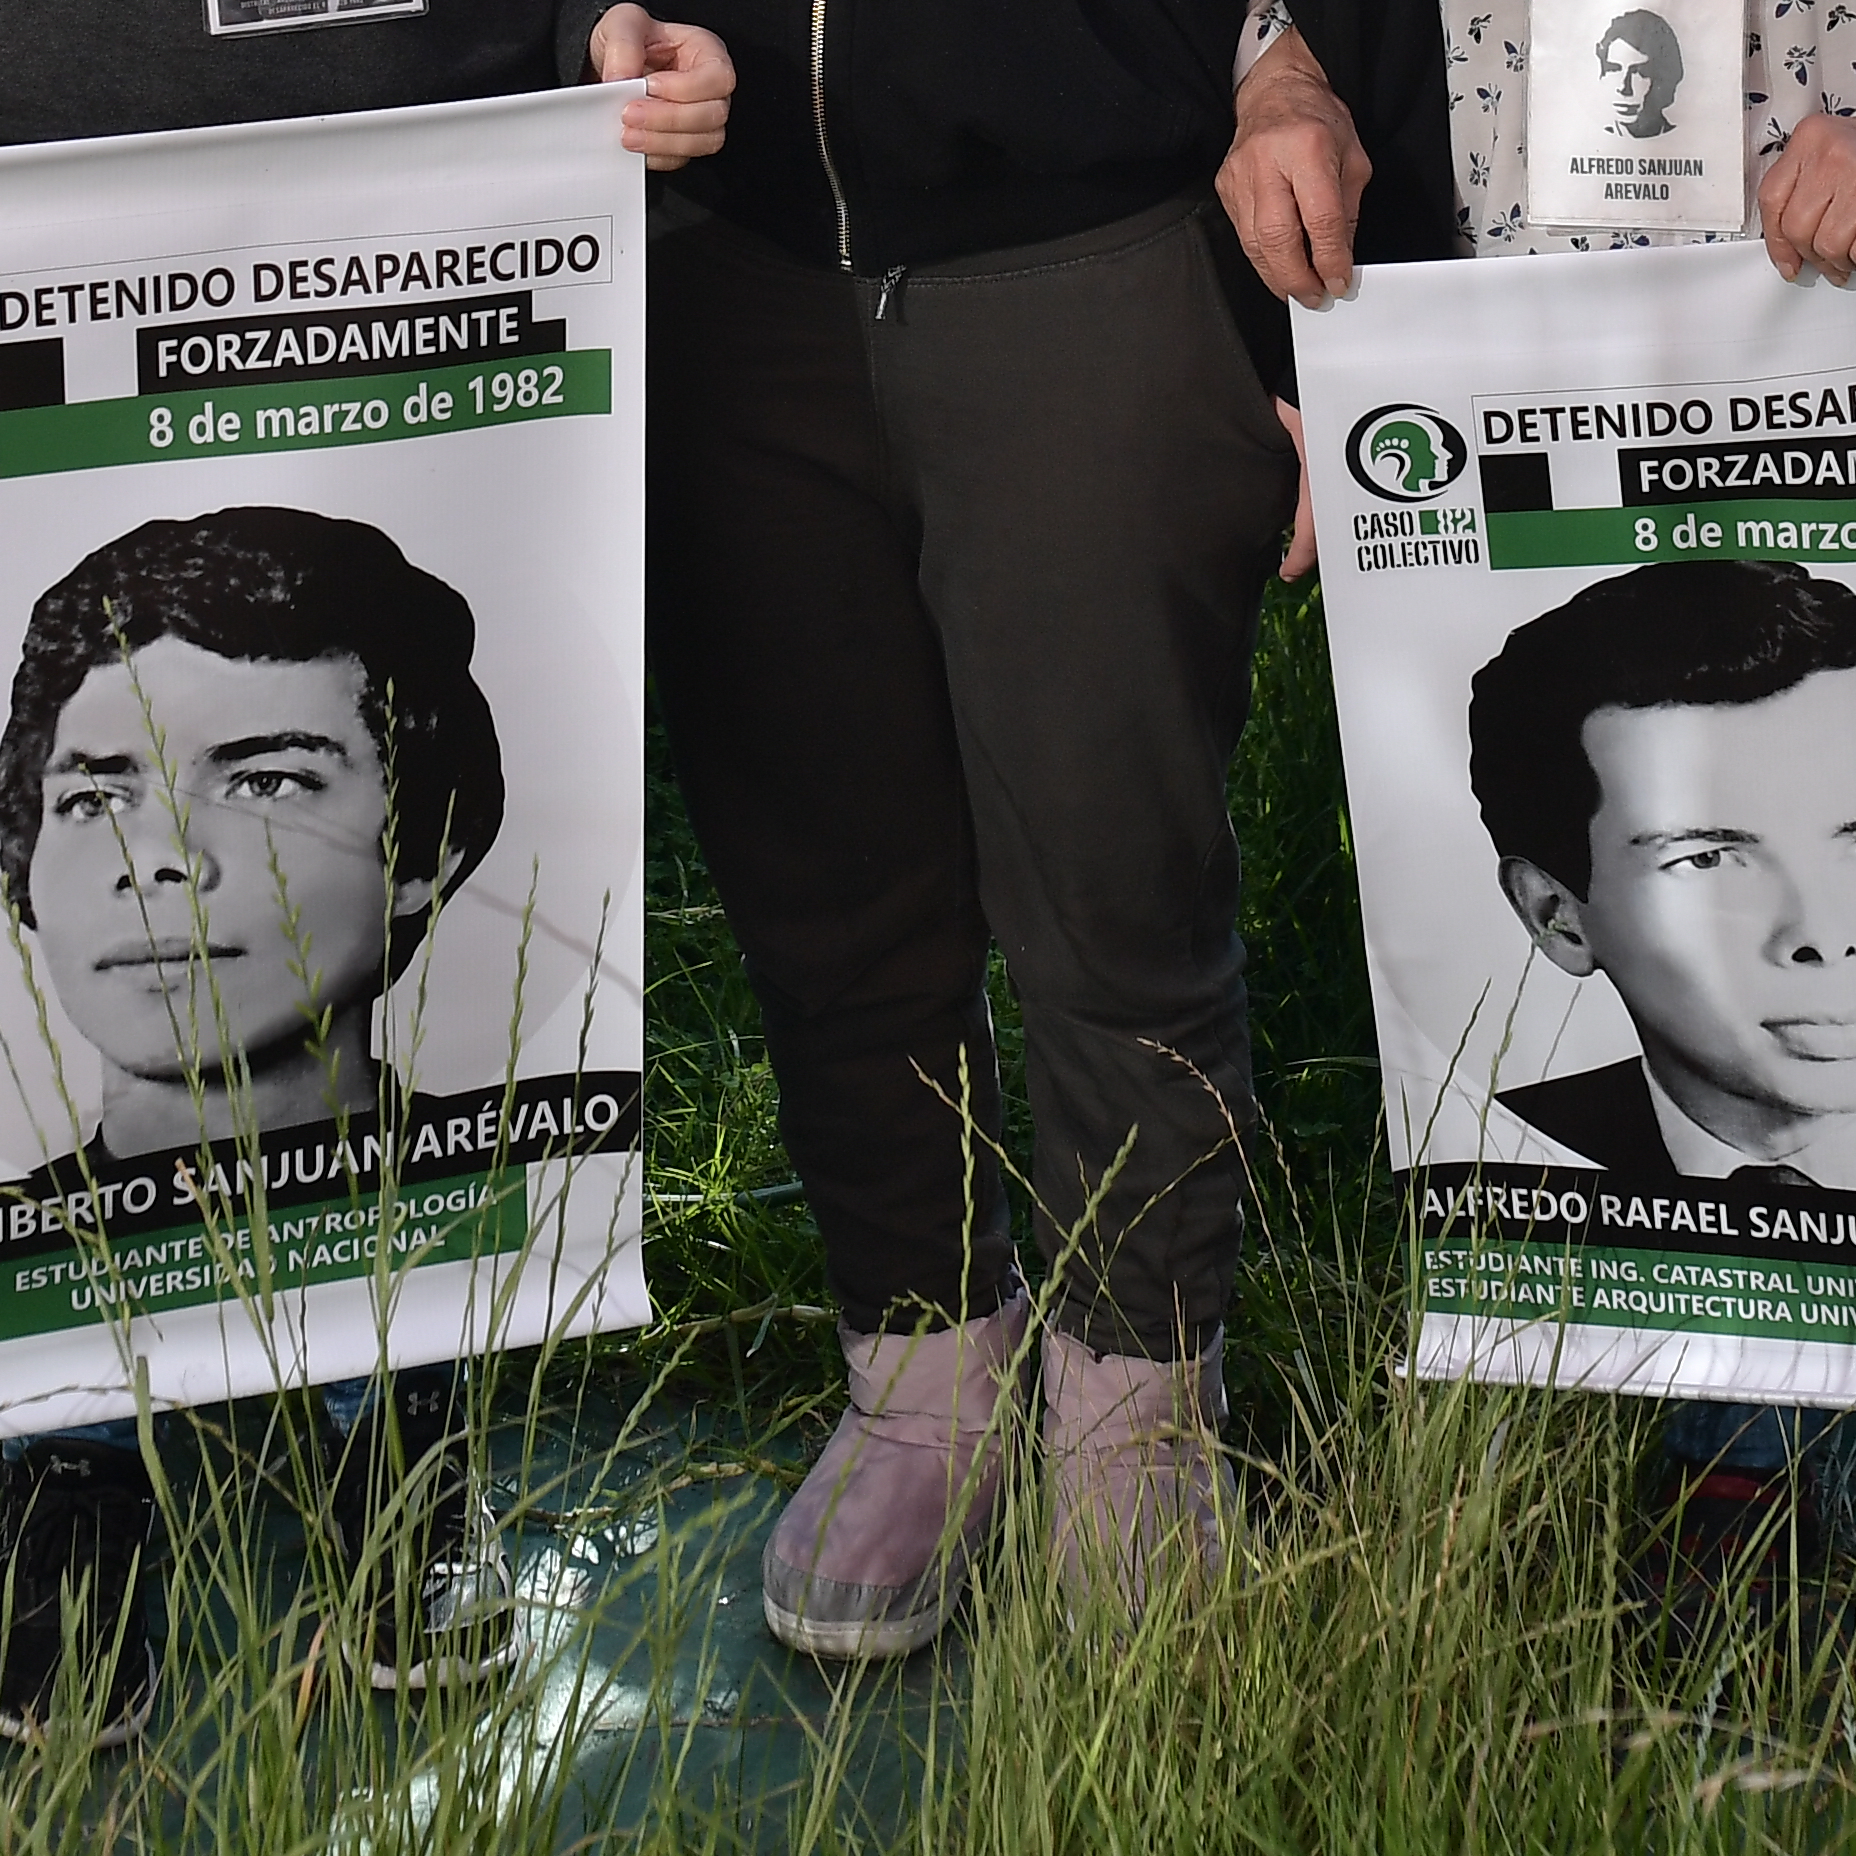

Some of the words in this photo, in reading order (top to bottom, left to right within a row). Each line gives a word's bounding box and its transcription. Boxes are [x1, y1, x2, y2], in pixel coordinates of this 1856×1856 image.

[1570, 157, 1634, 175] ALFREDO
[1638, 158, 1703, 176] SANJUAN
[1604, 182, 1669, 200] AREVALO
[252, 233, 601, 303] DESAPARECIDO
[157, 306, 521, 379] FORZADAMENTE
[148, 407, 174, 449] 8
[187, 401, 242, 446] de
[255, 397, 390, 441] marzo
[402, 380, 454, 424] de
[467, 365, 566, 416] 1982
[1483, 396, 1714, 447] DETENIDO
[1353, 510, 1414, 541] CASO
[1437, 508, 1476, 535] 82
[1634, 517, 1659, 552] 8
[1671, 513, 1724, 550] de
[1357, 538, 1480, 572] COLECTIVO
[410, 1093, 620, 1163] ARÉVALO
[1420, 1186, 1588, 1224] ALFREDO
[1600, 1193, 1740, 1236] RAFAEL
[15, 1233, 204, 1292] ESTUDIANTE
[219, 1227, 251, 1250] DE
[267, 1181, 498, 1245] ANTROPOLOGÍA
[287, 1224, 446, 1273] NACIONAL
[1424, 1249, 1584, 1279] ESTUDIANTE
[1591, 1258, 1645, 1284] ING.
[1652, 1263, 1800, 1295] CATASTRAL
[1593, 1287, 1793, 1323] ARQUITECTURA
